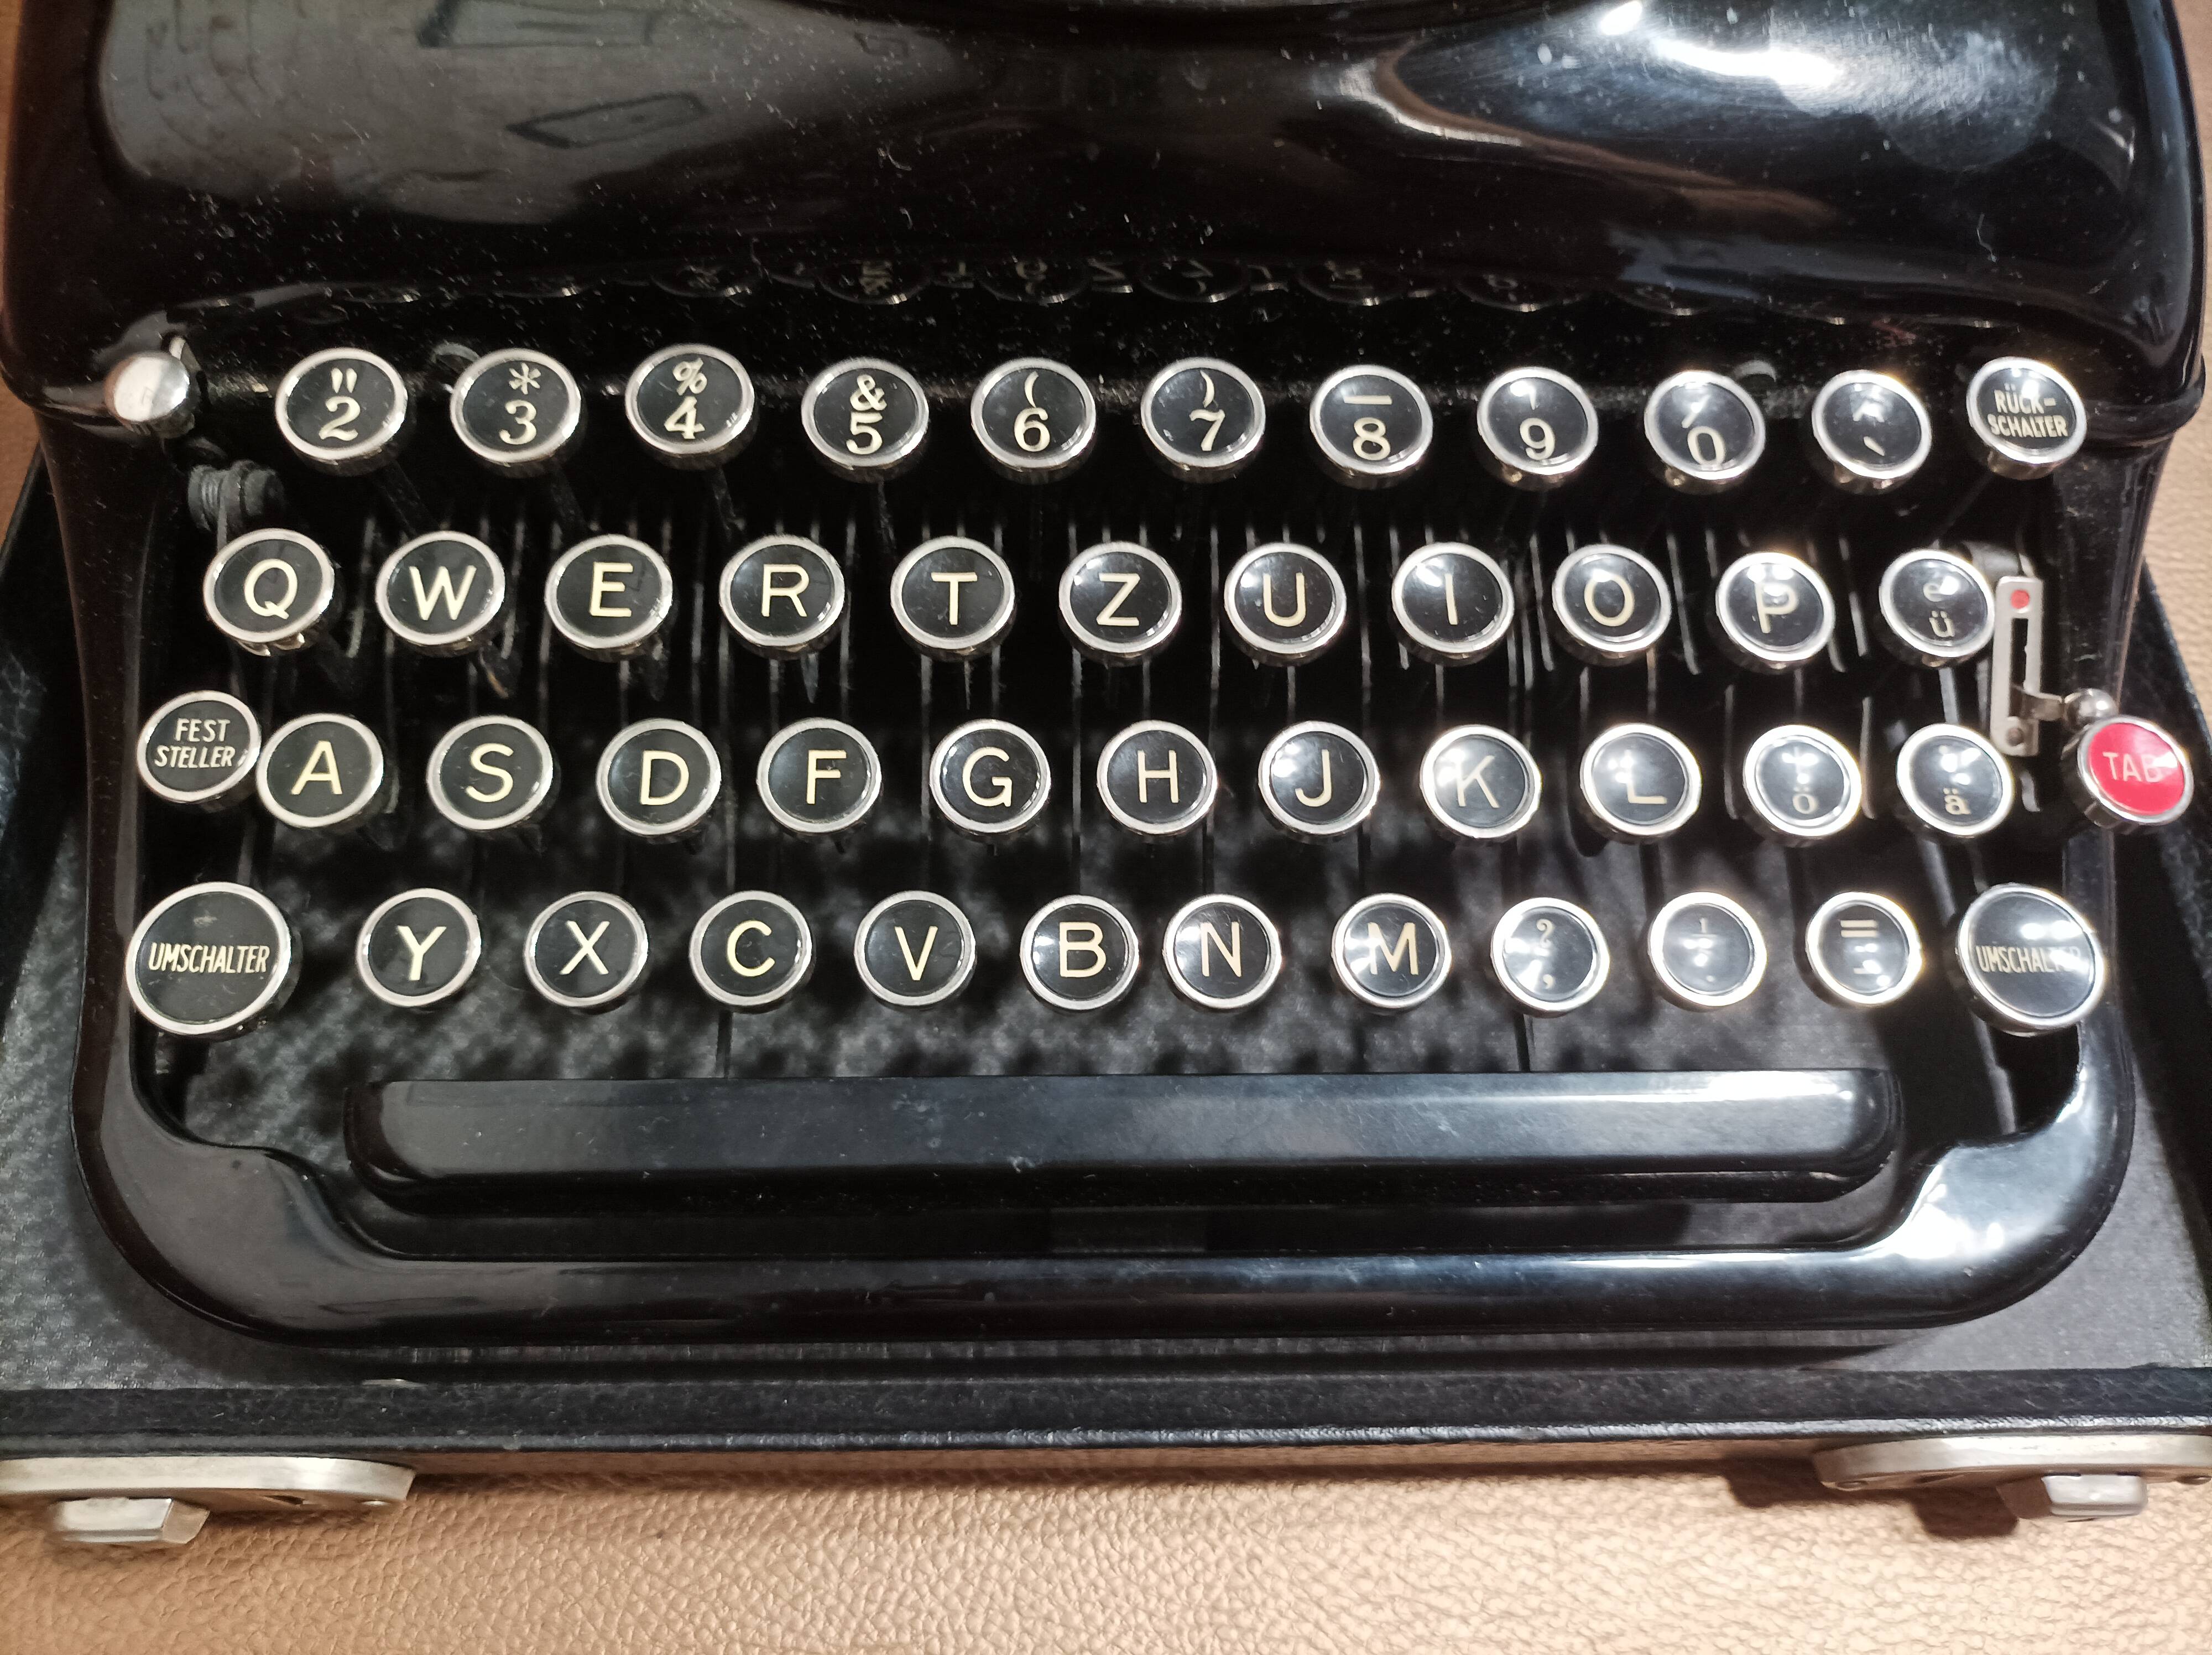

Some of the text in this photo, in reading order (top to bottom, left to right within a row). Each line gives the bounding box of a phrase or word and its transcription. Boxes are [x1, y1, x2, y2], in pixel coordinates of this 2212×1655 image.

[672, 358, 708, 396] %
[851, 374, 887, 410] &
[1024, 371, 1039, 408] (
[1200, 370, 1214, 408] )
[319, 396, 361, 441] 2
[499, 400, 536, 445] 3
[664, 396, 705, 439] 4
[846, 412, 883, 455] 5
[1014, 408, 1050, 451] 6
[1189, 408, 1225, 451] 7
[1353, 417, 1390, 460] 8
[1520, 418, 1555, 460] 9
[1987, 414, 2068, 438] SCHALTER
[244, 558, 298, 620] Q
[409, 565, 477, 620] W
[589, 561, 633, 617] E
[760, 564, 809, 617] R
[931, 571, 977, 625] T
[1096, 573, 1140, 626] Z
[1262, 572, 1306, 627] U
[1444, 573, 1458, 625] I
[1584, 573, 1635, 626] O
[1754, 581, 1799, 634] P
[1929, 610, 1955, 637] ü
[154, 746, 236, 768] STELLER
[175, 719, 231, 742] FEST
[291, 741, 342, 795] A
[466, 743, 514, 803] S
[640, 750, 689, 805] D
[806, 749, 847, 804] F
[962, 746, 1012, 808] G
[1137, 749, 1178, 803] H
[1295, 749, 1332, 807] J
[1453, 755, 1500, 808] K
[1625, 751, 1667, 804] L
[2103, 752, 2164, 783] TAB
[1944, 788, 1970, 815] ä
[397, 925, 447, 981] Y
[560, 920, 610, 975] X
[727, 919, 775, 977] C
[894, 926, 938, 981] V
[1058, 921, 1107, 977] B
[1200, 921, 1241, 977] N
[1367, 922, 1419, 975] M
[1840, 920, 1878, 938] =
[149, 942, 269, 974] UMSCHALTER
